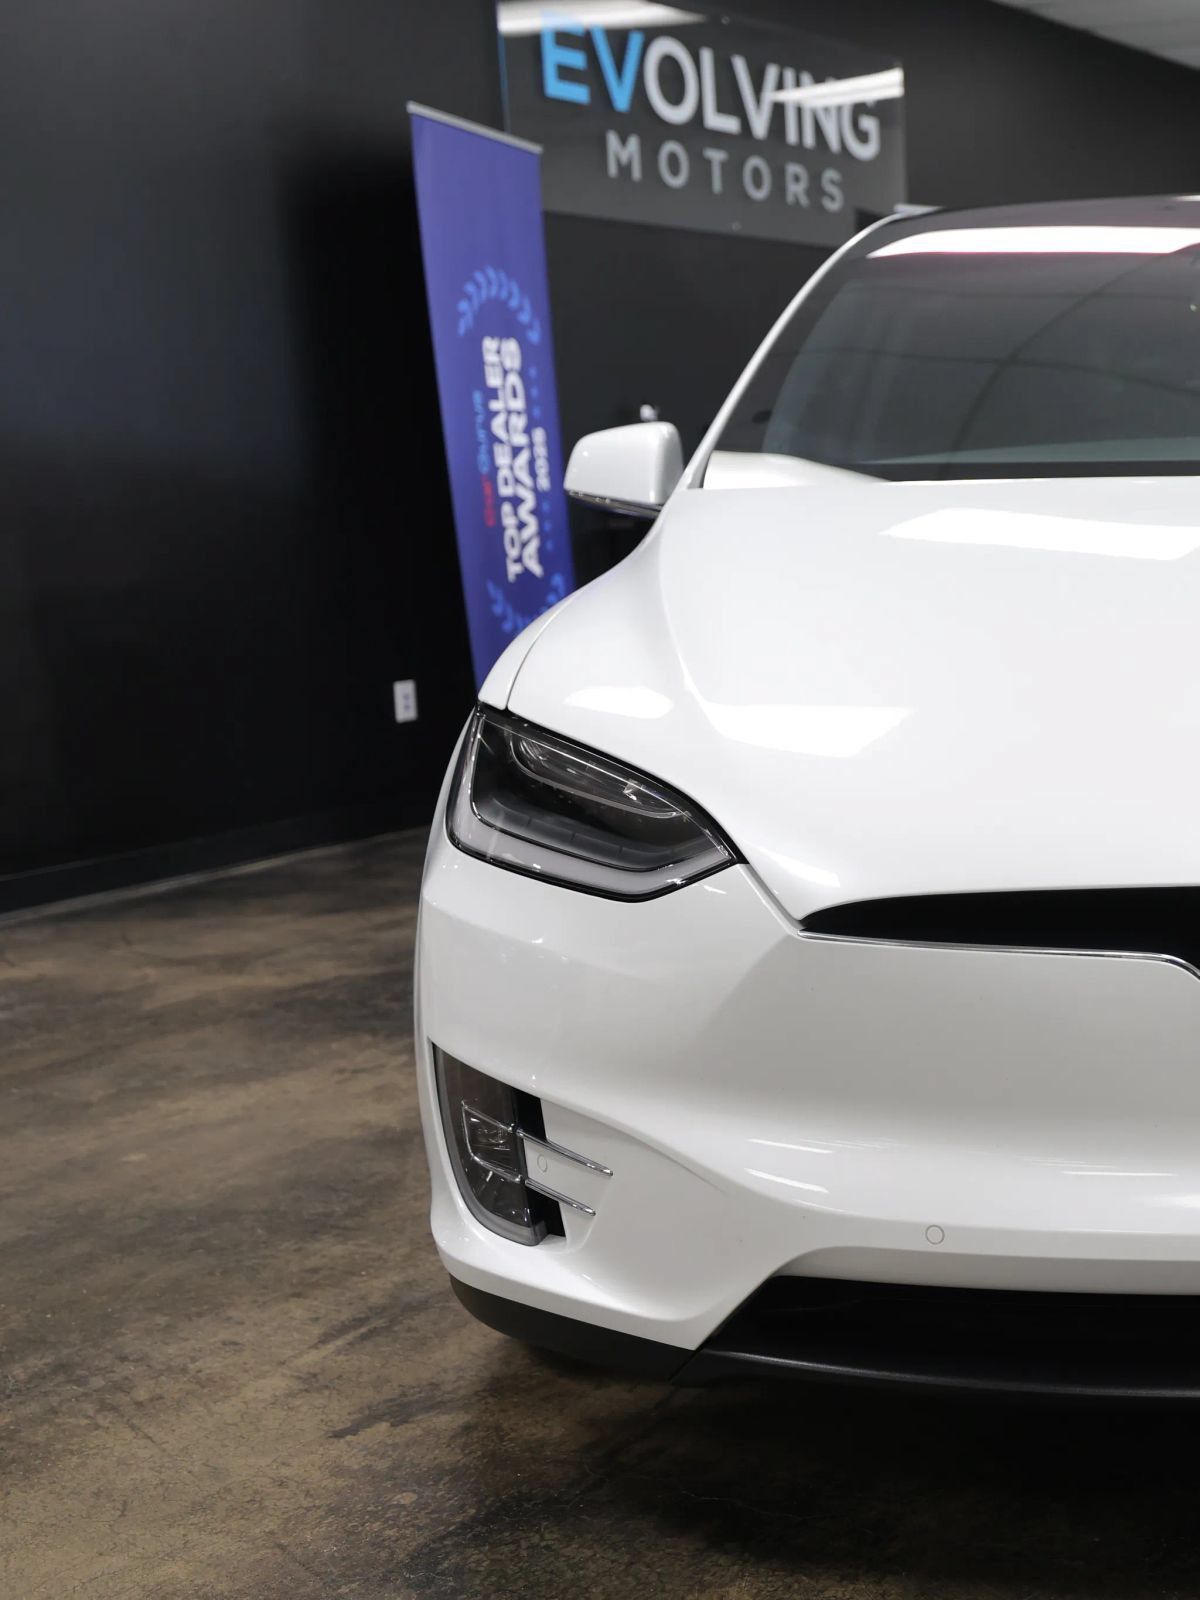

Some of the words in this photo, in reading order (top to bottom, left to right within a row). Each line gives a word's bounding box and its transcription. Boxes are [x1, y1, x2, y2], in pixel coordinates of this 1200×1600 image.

[541, 10, 881, 160] EVOLVING
[605, 129, 845, 212] MOTORS
[482, 336, 516, 498] DEALER
[499, 337, 544, 578] AWARDS
[500, 501, 524, 582] TOP
